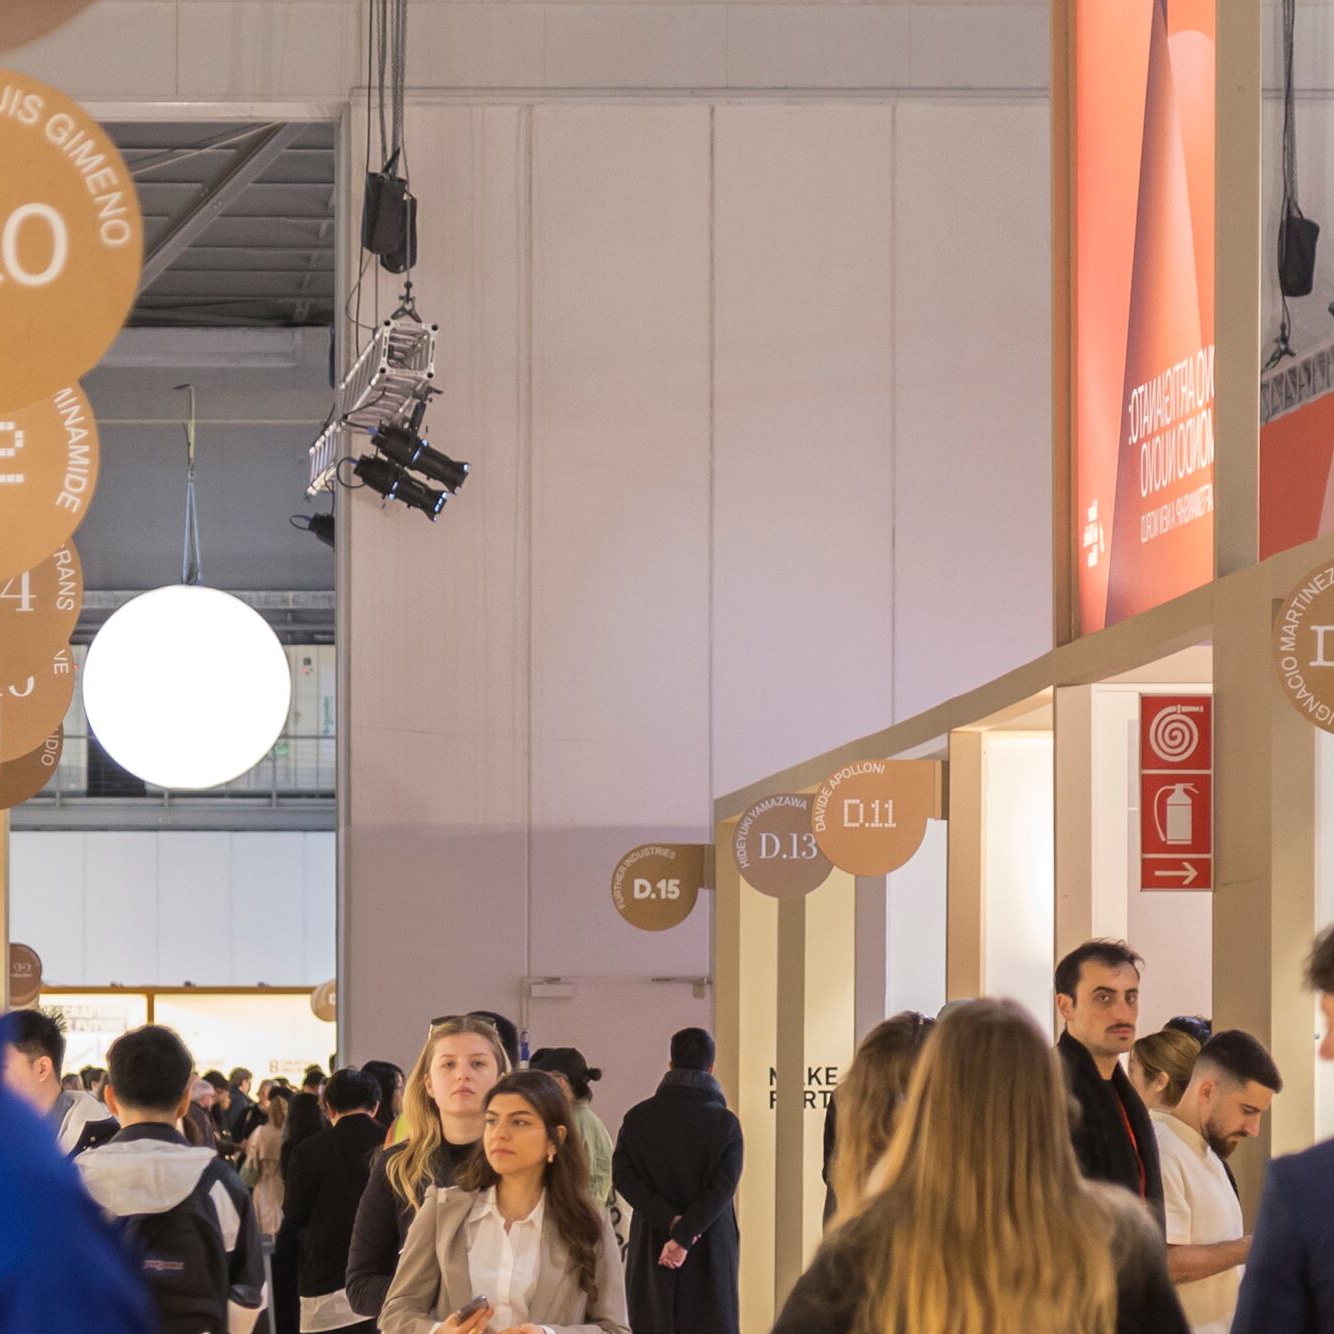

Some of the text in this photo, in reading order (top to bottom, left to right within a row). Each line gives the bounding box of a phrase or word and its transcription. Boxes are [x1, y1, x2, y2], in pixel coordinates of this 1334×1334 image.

[44, 112, 132, 246] GIMENO
[53, 543, 76, 611] RANS
[814, 762, 885, 833] DAVIDE APOLLONI
[843, 799, 897, 828] D.11
[736, 796, 808, 869] HIDEYUKI YAMAZAWA
[758, 832, 818, 860] D.13
[633, 878, 681, 900] D.15
[769, 1066, 839, 1086] KE
